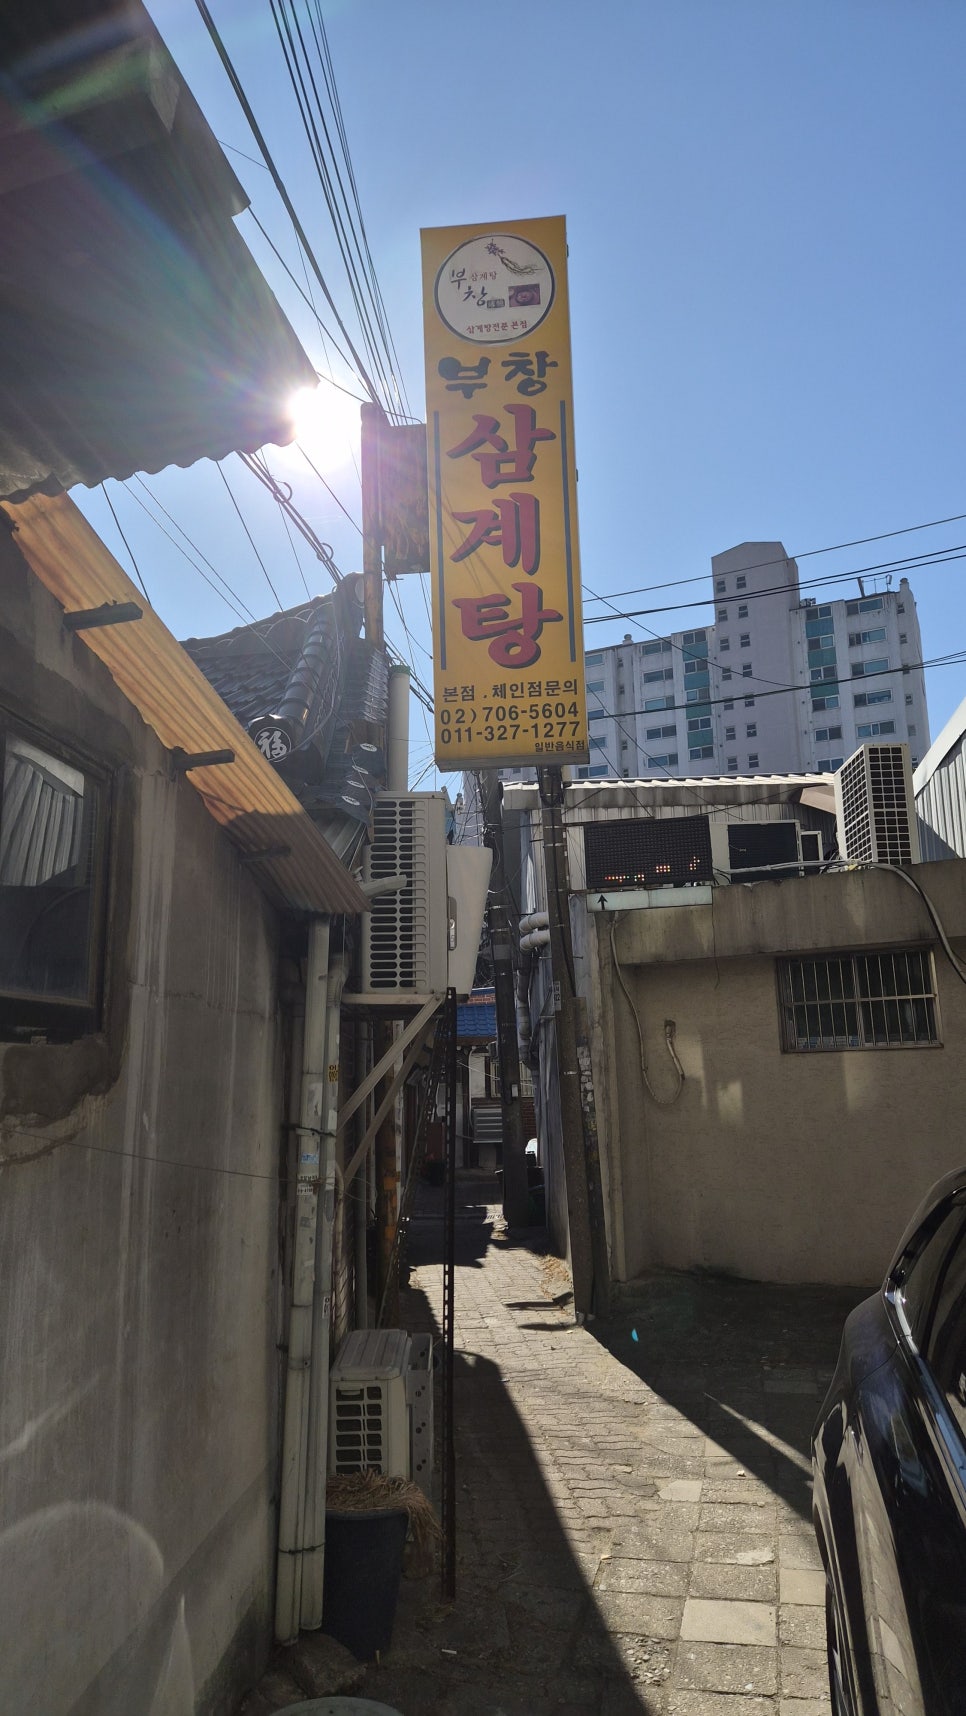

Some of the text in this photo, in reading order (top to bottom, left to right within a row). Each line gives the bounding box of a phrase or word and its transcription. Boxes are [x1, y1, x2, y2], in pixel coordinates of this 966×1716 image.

[438, 350, 559, 399] 부창
[446, 403, 564, 669] 삼계탕
[442, 685, 475, 703] 본점
[492, 679, 578, 699] 체인점문의
[440, 701, 579, 725] 02)706-5604
[258, 730, 287, 758] 福
[440, 721, 580, 744] 011-327-1277
[534, 740, 585, 753] 일반음식점
